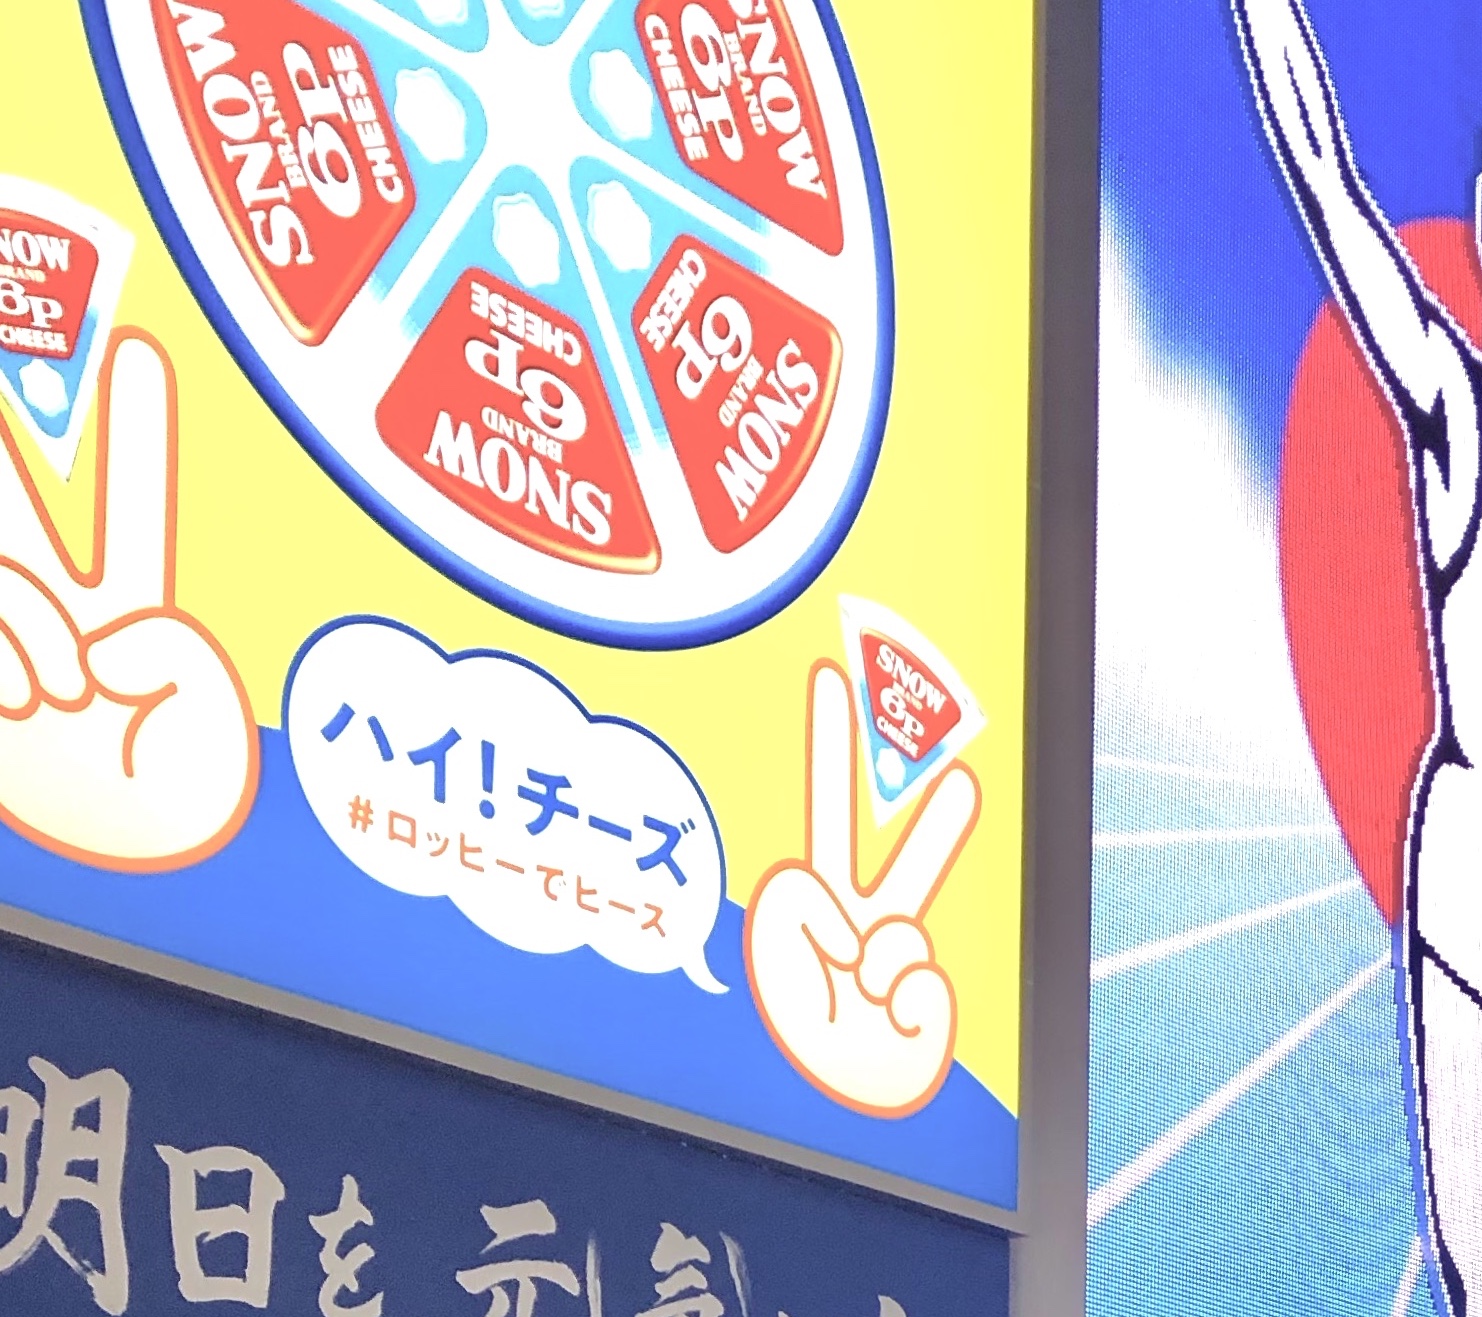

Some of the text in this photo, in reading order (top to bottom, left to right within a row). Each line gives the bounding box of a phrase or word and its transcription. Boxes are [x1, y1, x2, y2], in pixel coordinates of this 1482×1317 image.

[282, 41, 362, 218] 6P
[327, 44, 405, 203] CHEESE
[644, 14, 709, 161] CHEESE
[680, 2, 744, 162] 6P
[464, 328, 588, 442] 6P
[470, 281, 582, 367] CHEESE
[671, 296, 753, 400] 6P
[423, 410, 612, 546] SNOW
[480, 405, 563, 464] BRAND
[714, 338, 819, 523] SNOW
[876, 643, 947, 715] SNOW
